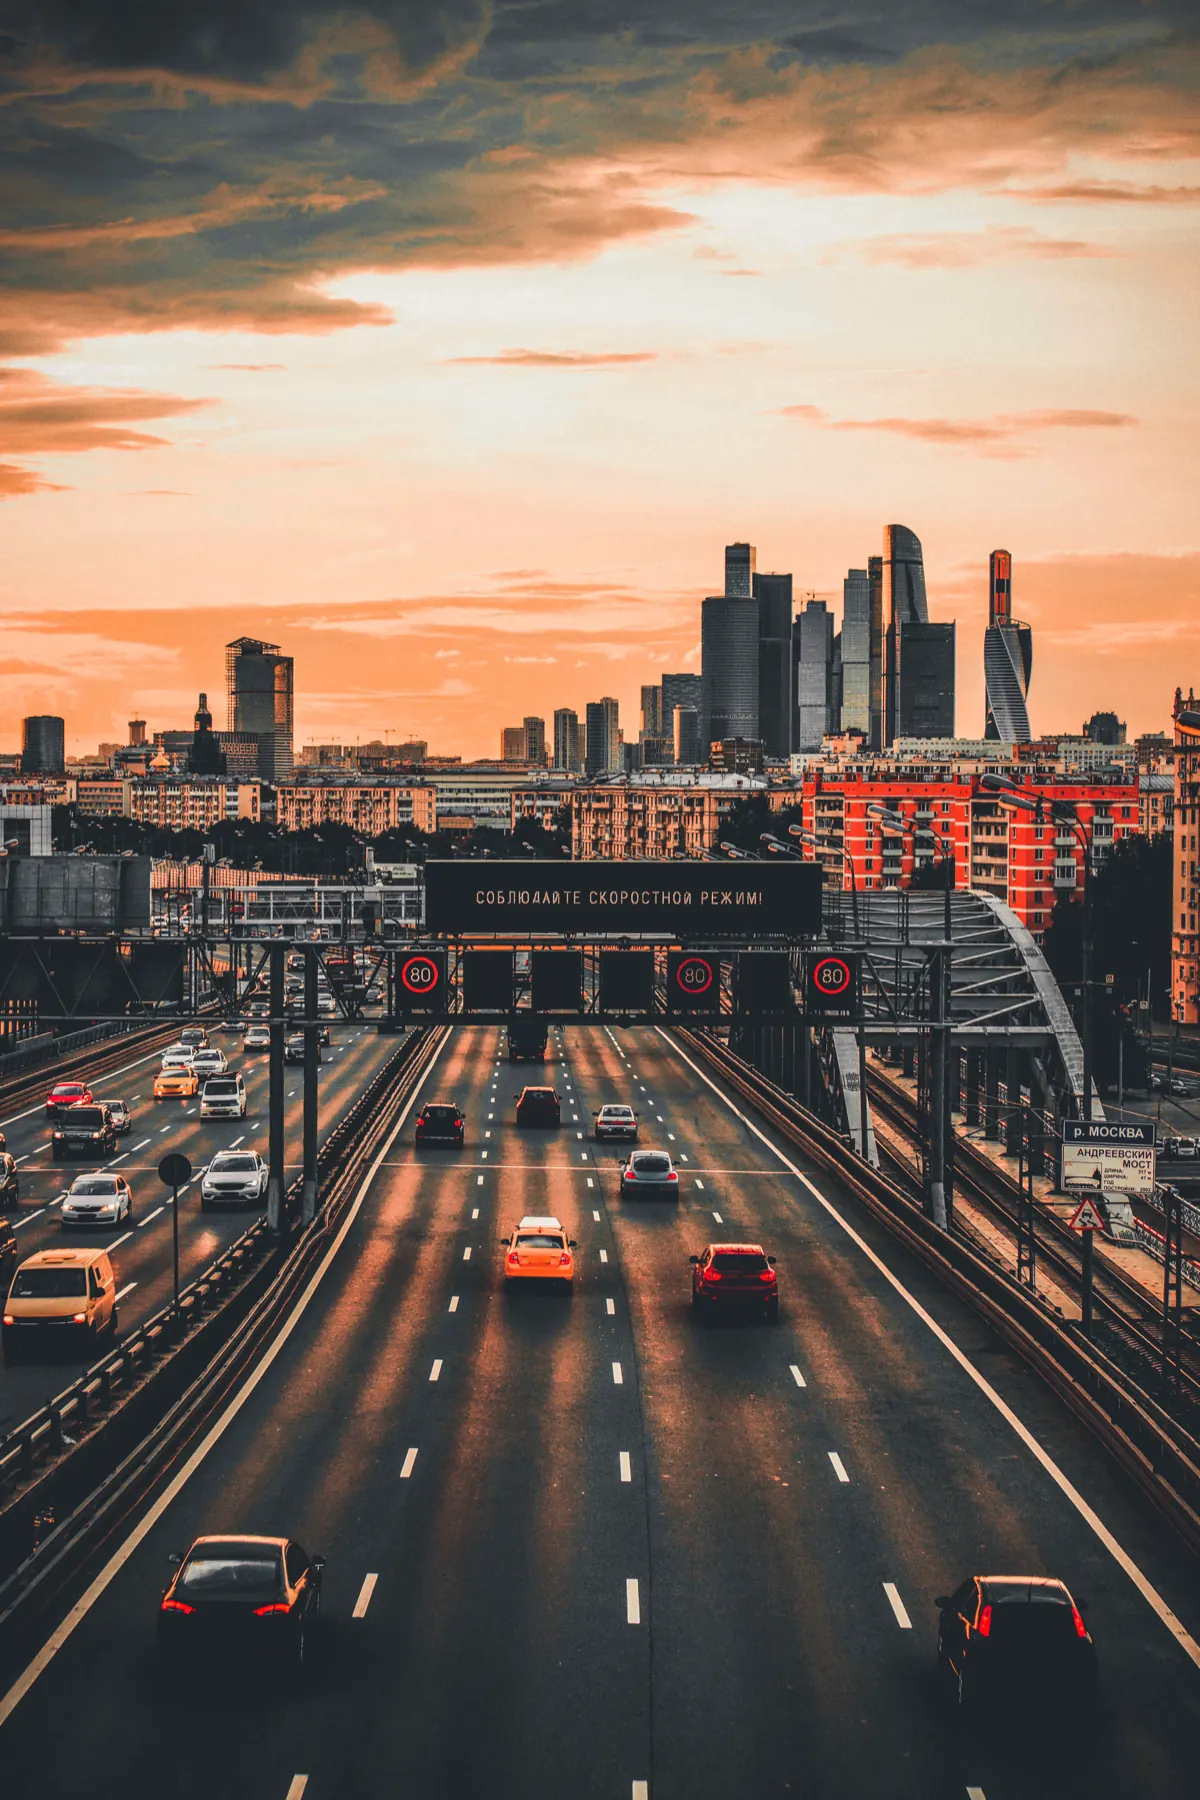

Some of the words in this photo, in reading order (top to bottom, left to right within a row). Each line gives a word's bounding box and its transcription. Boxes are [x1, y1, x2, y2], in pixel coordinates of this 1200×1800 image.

[475, 890, 582, 905] СОБЛЮДАЙТЕ
[588, 890, 692, 905] СКОРОСТНОЙ
[700, 890, 763, 905] РЕЖИМ!
[410, 967, 431, 983] 80
[685, 968, 705, 983] 80
[822, 968, 843, 984] 80
[1074, 1127, 1085, 1138] р.
[1089, 1126, 1144, 1139] МОСКВА
[1076, 1148, 1152, 1159] АНДРЕЕВСКИЙ
[1122, 1160, 1152, 1169] МОСТ
